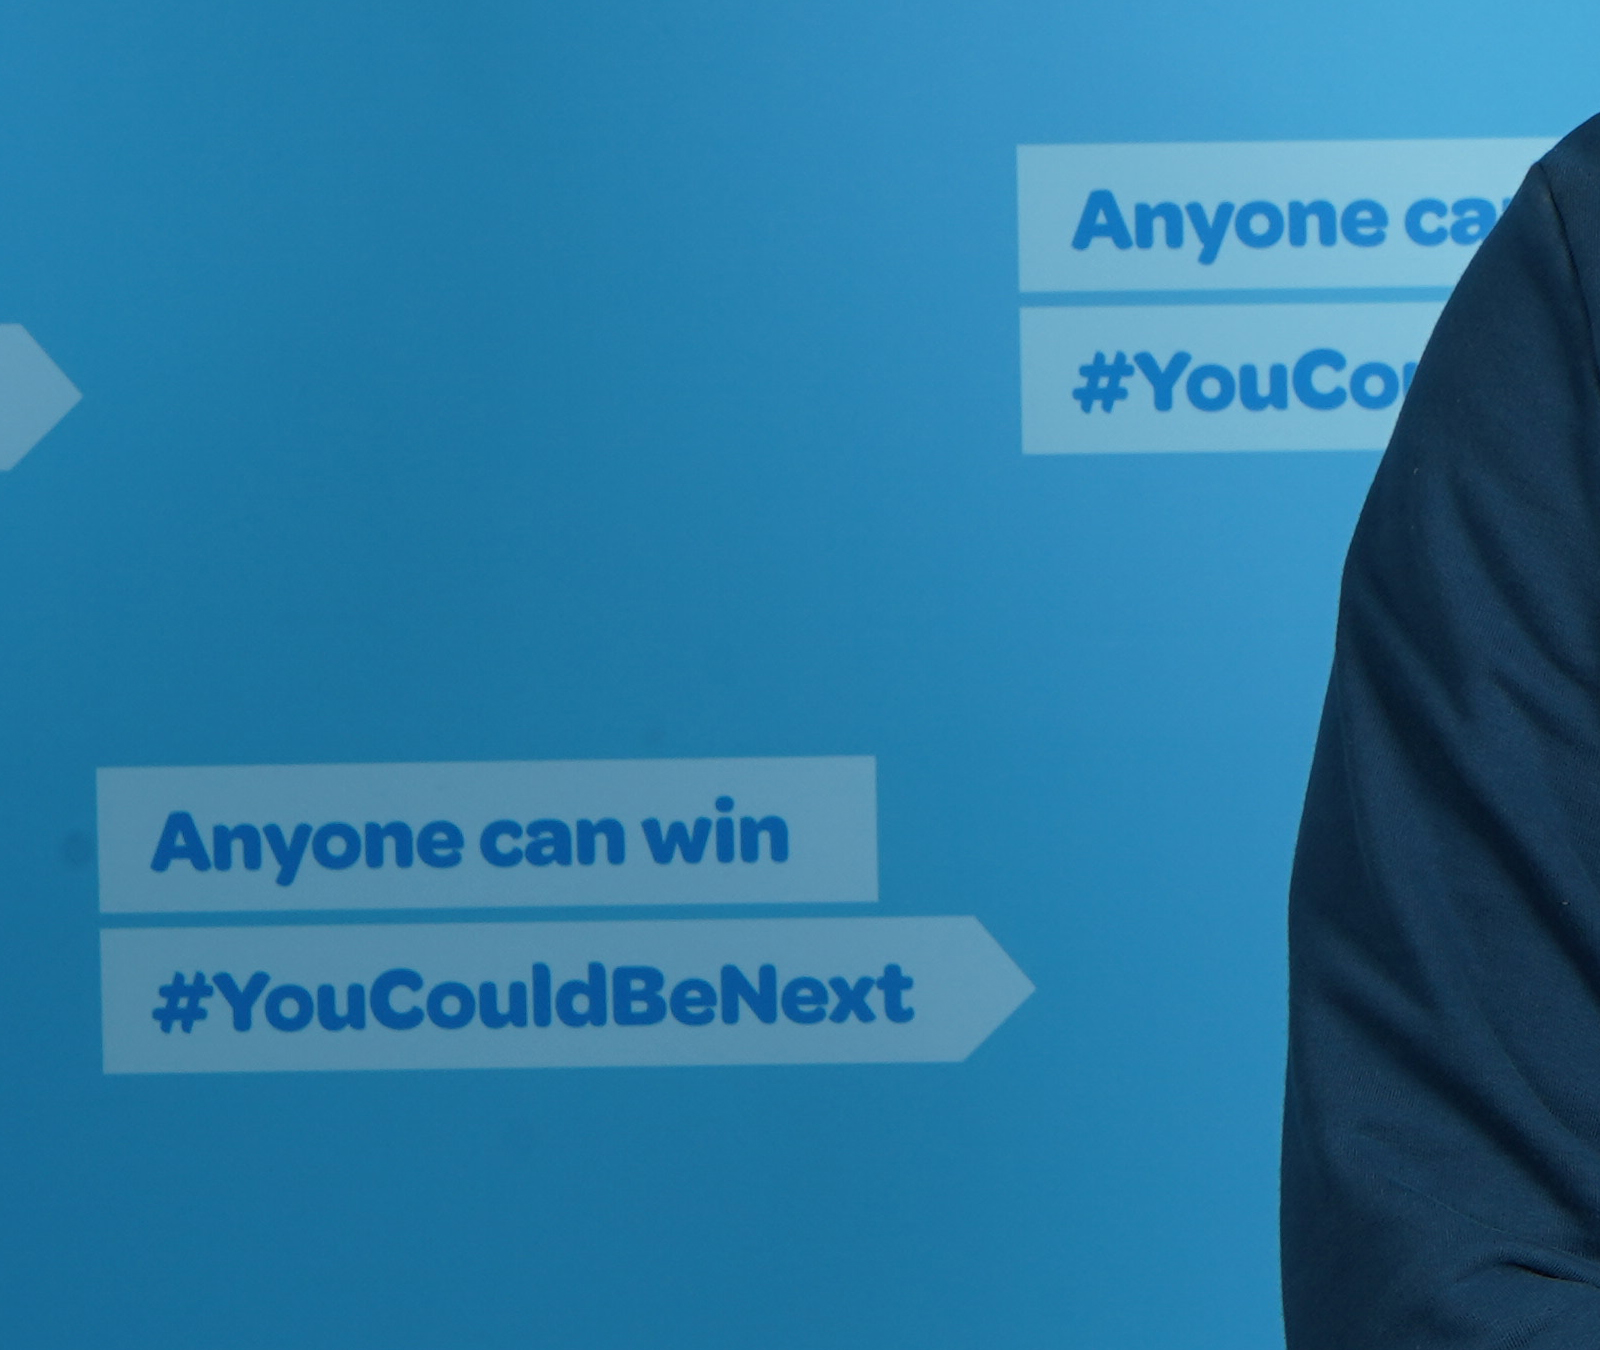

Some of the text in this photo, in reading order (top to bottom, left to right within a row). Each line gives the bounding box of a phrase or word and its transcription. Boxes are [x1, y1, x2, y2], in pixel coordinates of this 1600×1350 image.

[1072, 189, 1511, 265] Anyone ca
[1072, 348, 1417, 413] #YouCo
[151, 796, 789, 887] Anyone can win
[152, 961, 914, 1034] #YouCouldBeNext
